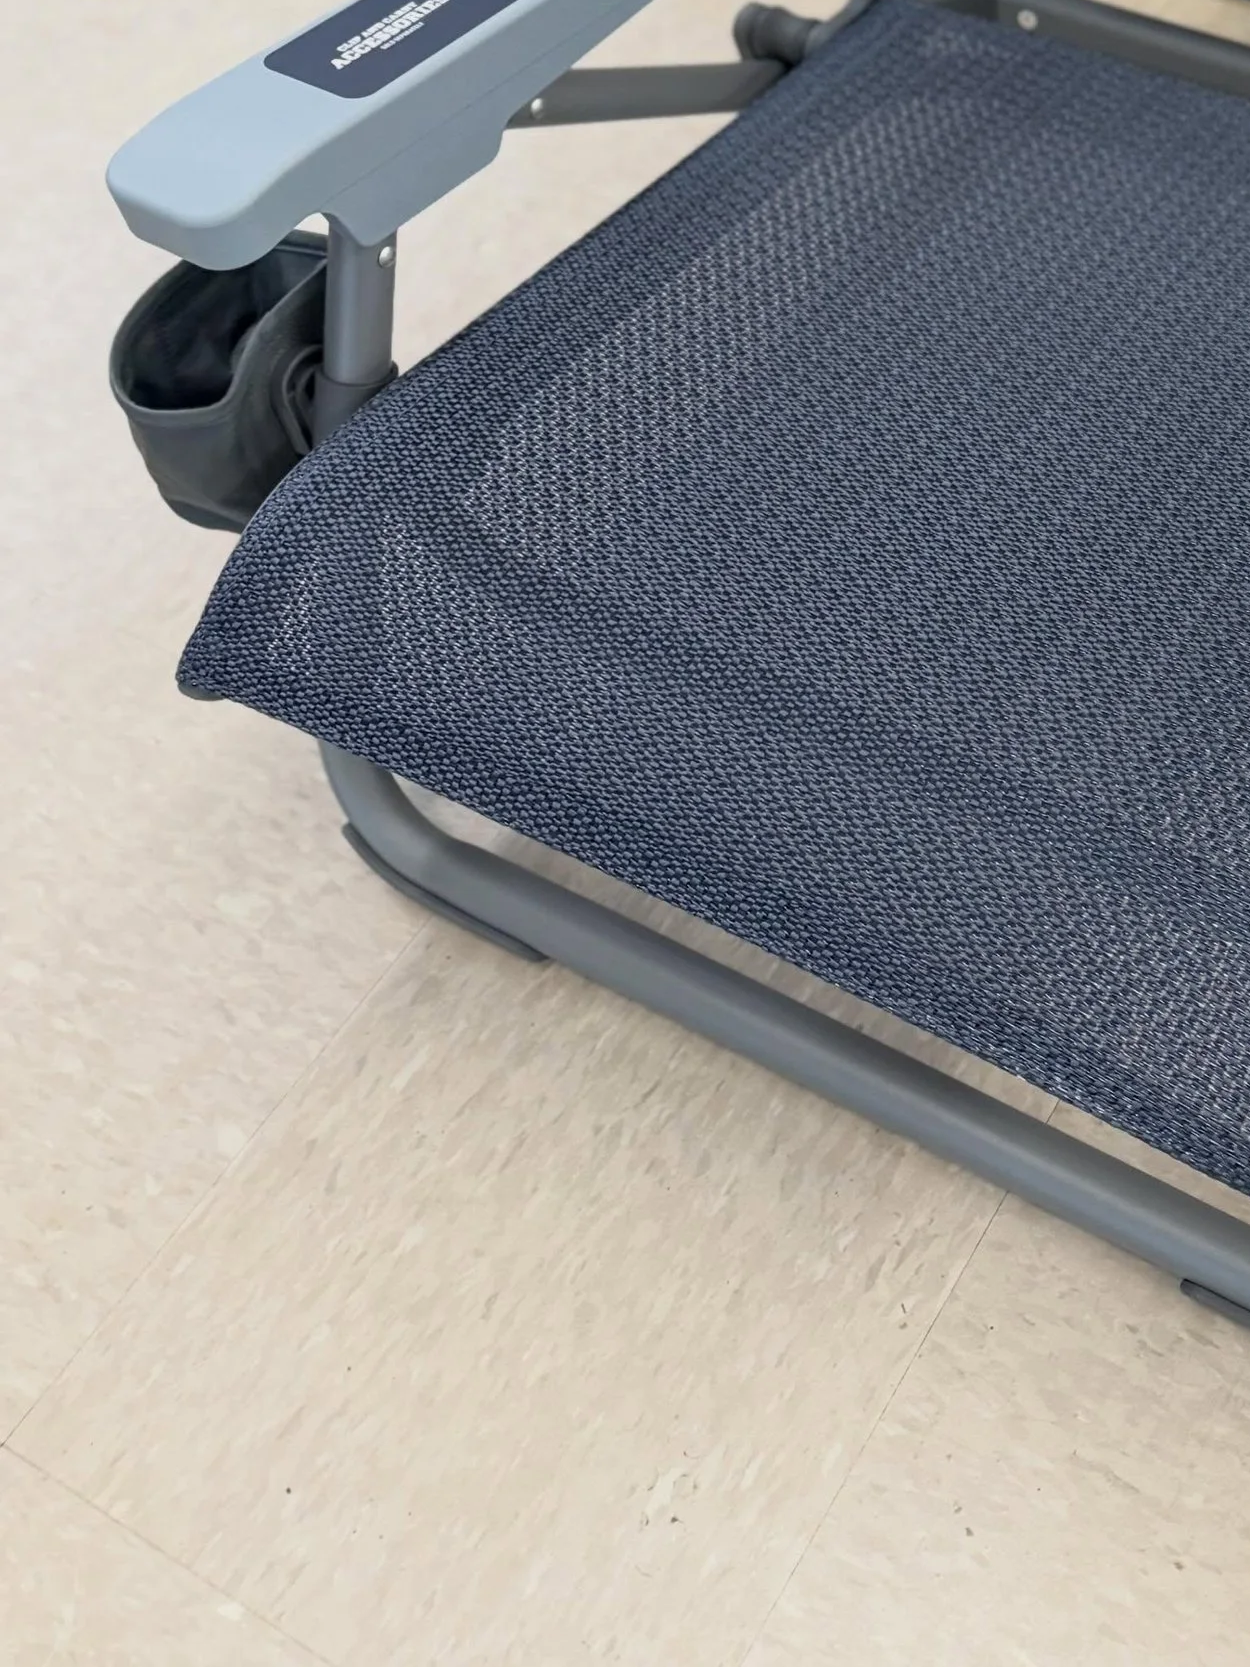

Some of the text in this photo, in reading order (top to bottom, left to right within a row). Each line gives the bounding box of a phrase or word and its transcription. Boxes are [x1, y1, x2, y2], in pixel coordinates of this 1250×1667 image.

[336, 2, 418, 52] CLIP AND CARRY
